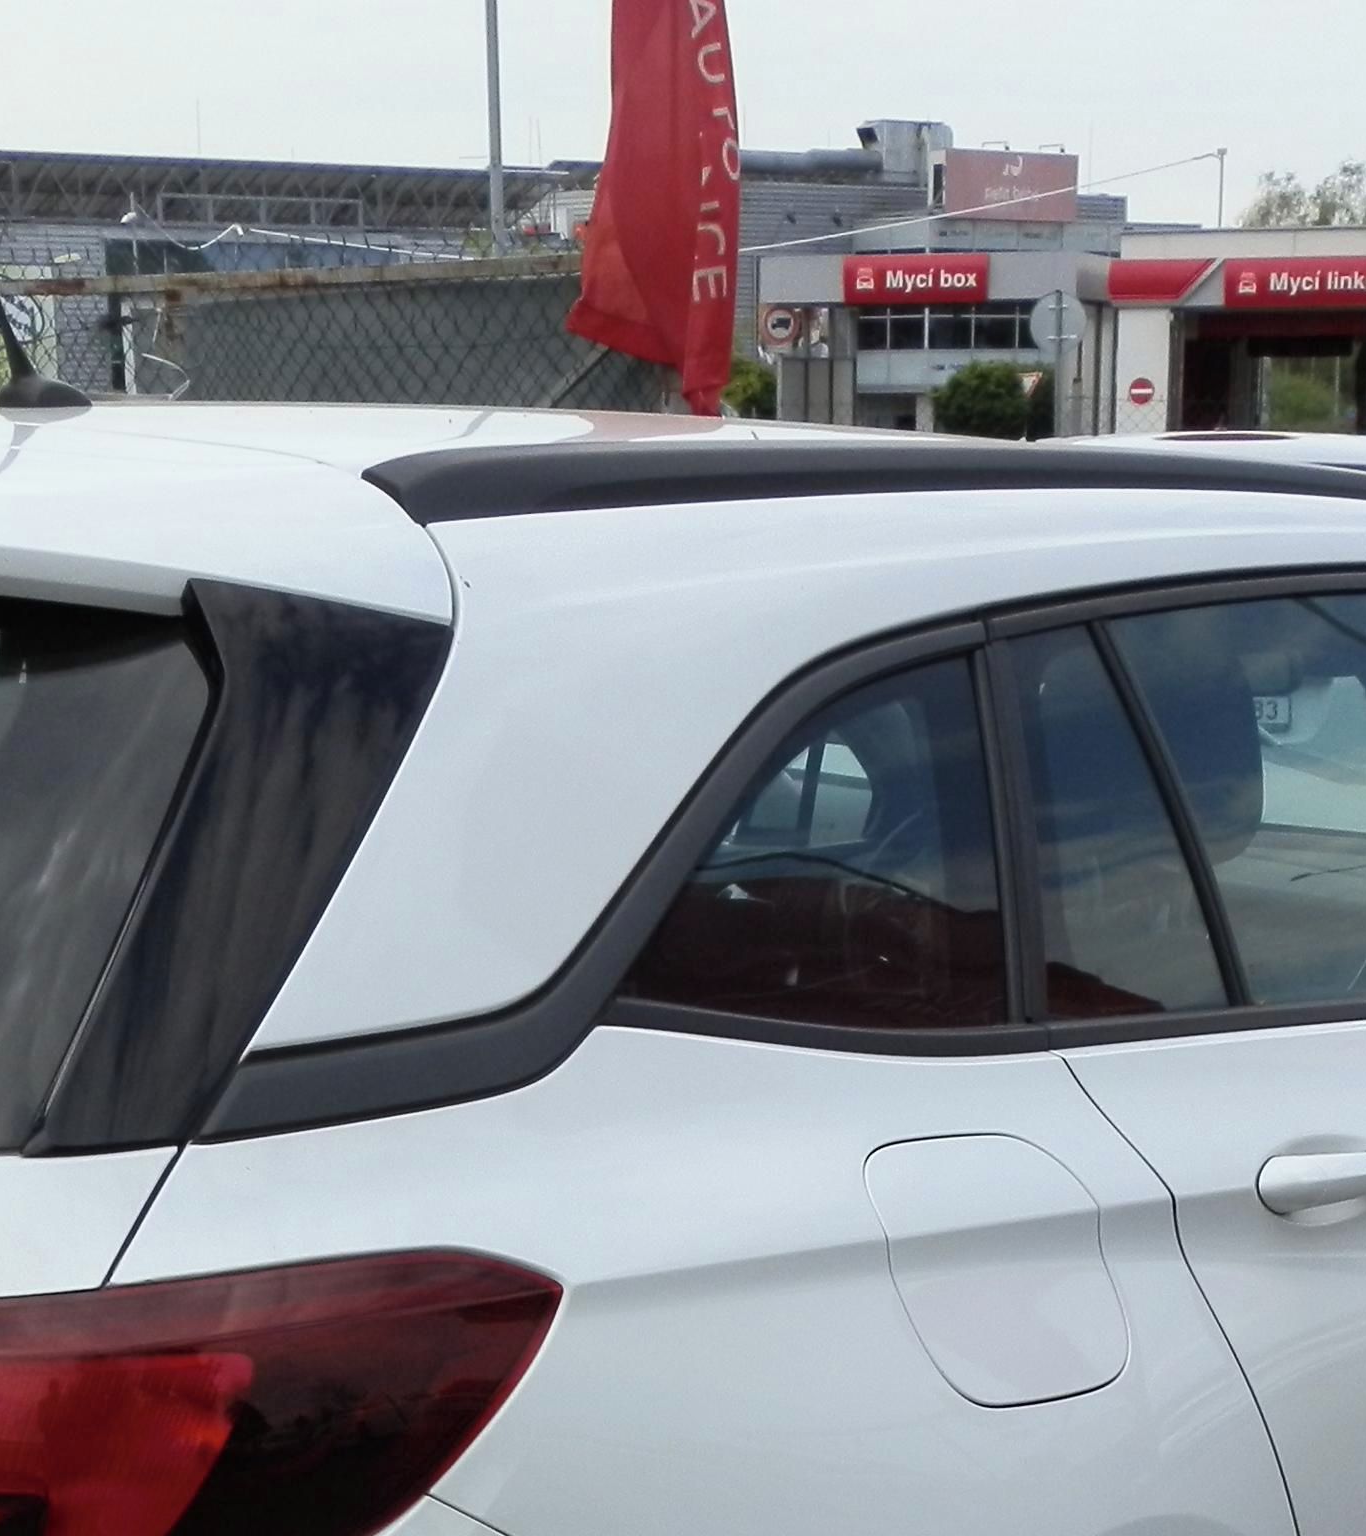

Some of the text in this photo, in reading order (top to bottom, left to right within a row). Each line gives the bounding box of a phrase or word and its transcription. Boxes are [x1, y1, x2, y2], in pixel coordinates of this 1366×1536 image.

[885, 268, 977, 294] Mycí box
[1269, 270, 1321, 296] Mycí
